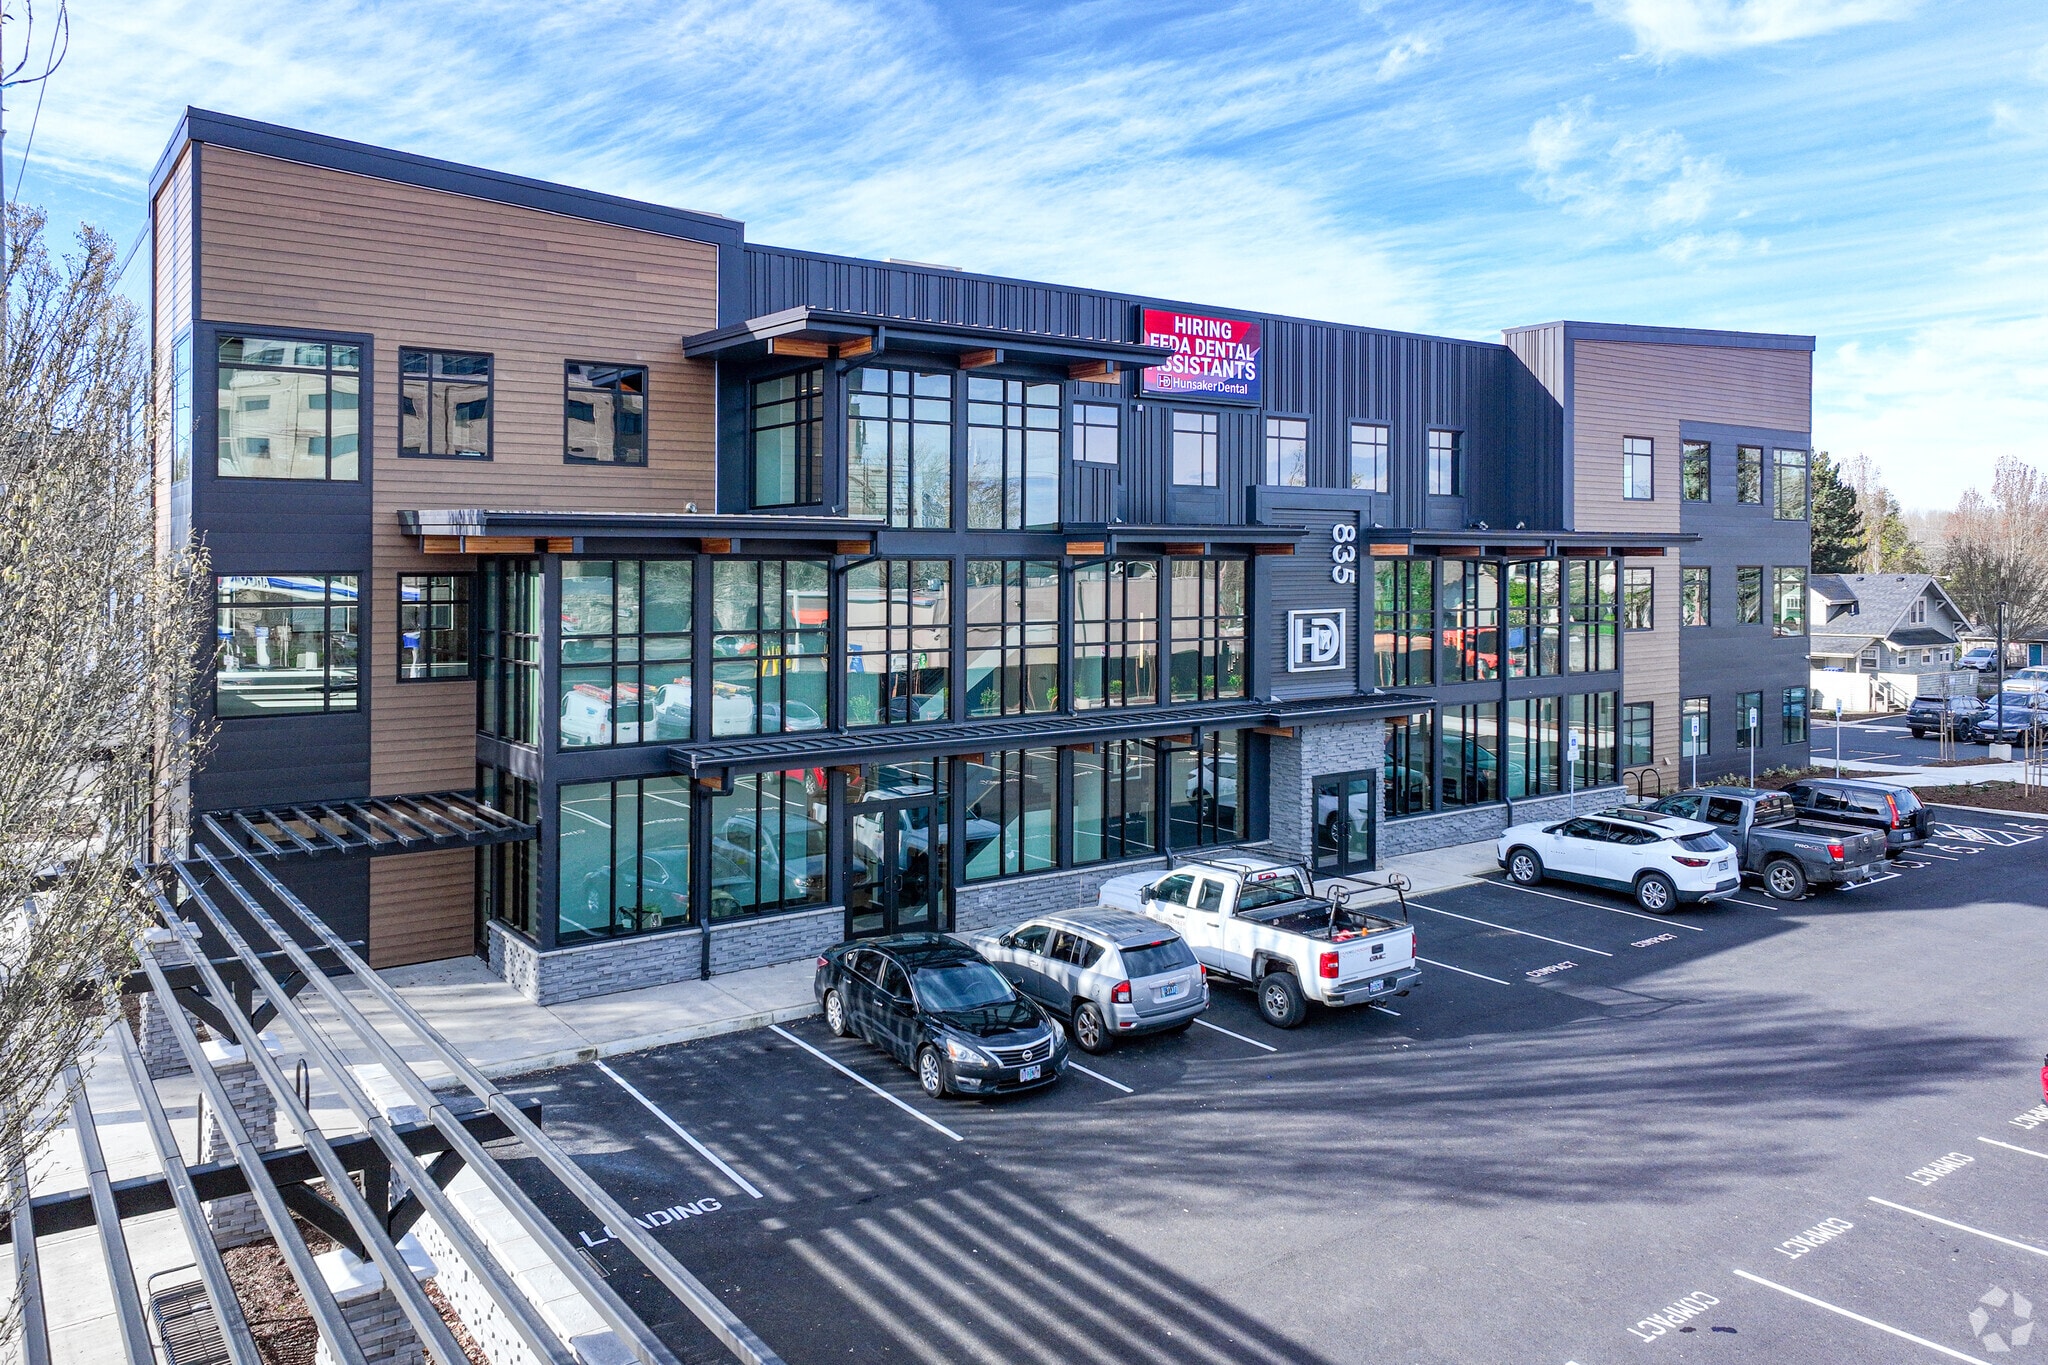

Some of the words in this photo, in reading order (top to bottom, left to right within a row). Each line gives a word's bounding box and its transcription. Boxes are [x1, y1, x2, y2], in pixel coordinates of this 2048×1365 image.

[1174, 316, 1232, 340] HIRING
[1148, 354, 1255, 381] SSISTANTS
[1195, 339, 1254, 362] DENTAL
[1332, 523, 1356, 585] 835
[1294, 617, 1340, 664] HD
[1904, 1152, 1976, 1187] COMPACT
[1773, 1217, 1854, 1260] COMPACT
[1626, 1290, 1720, 1343] COMPACT
